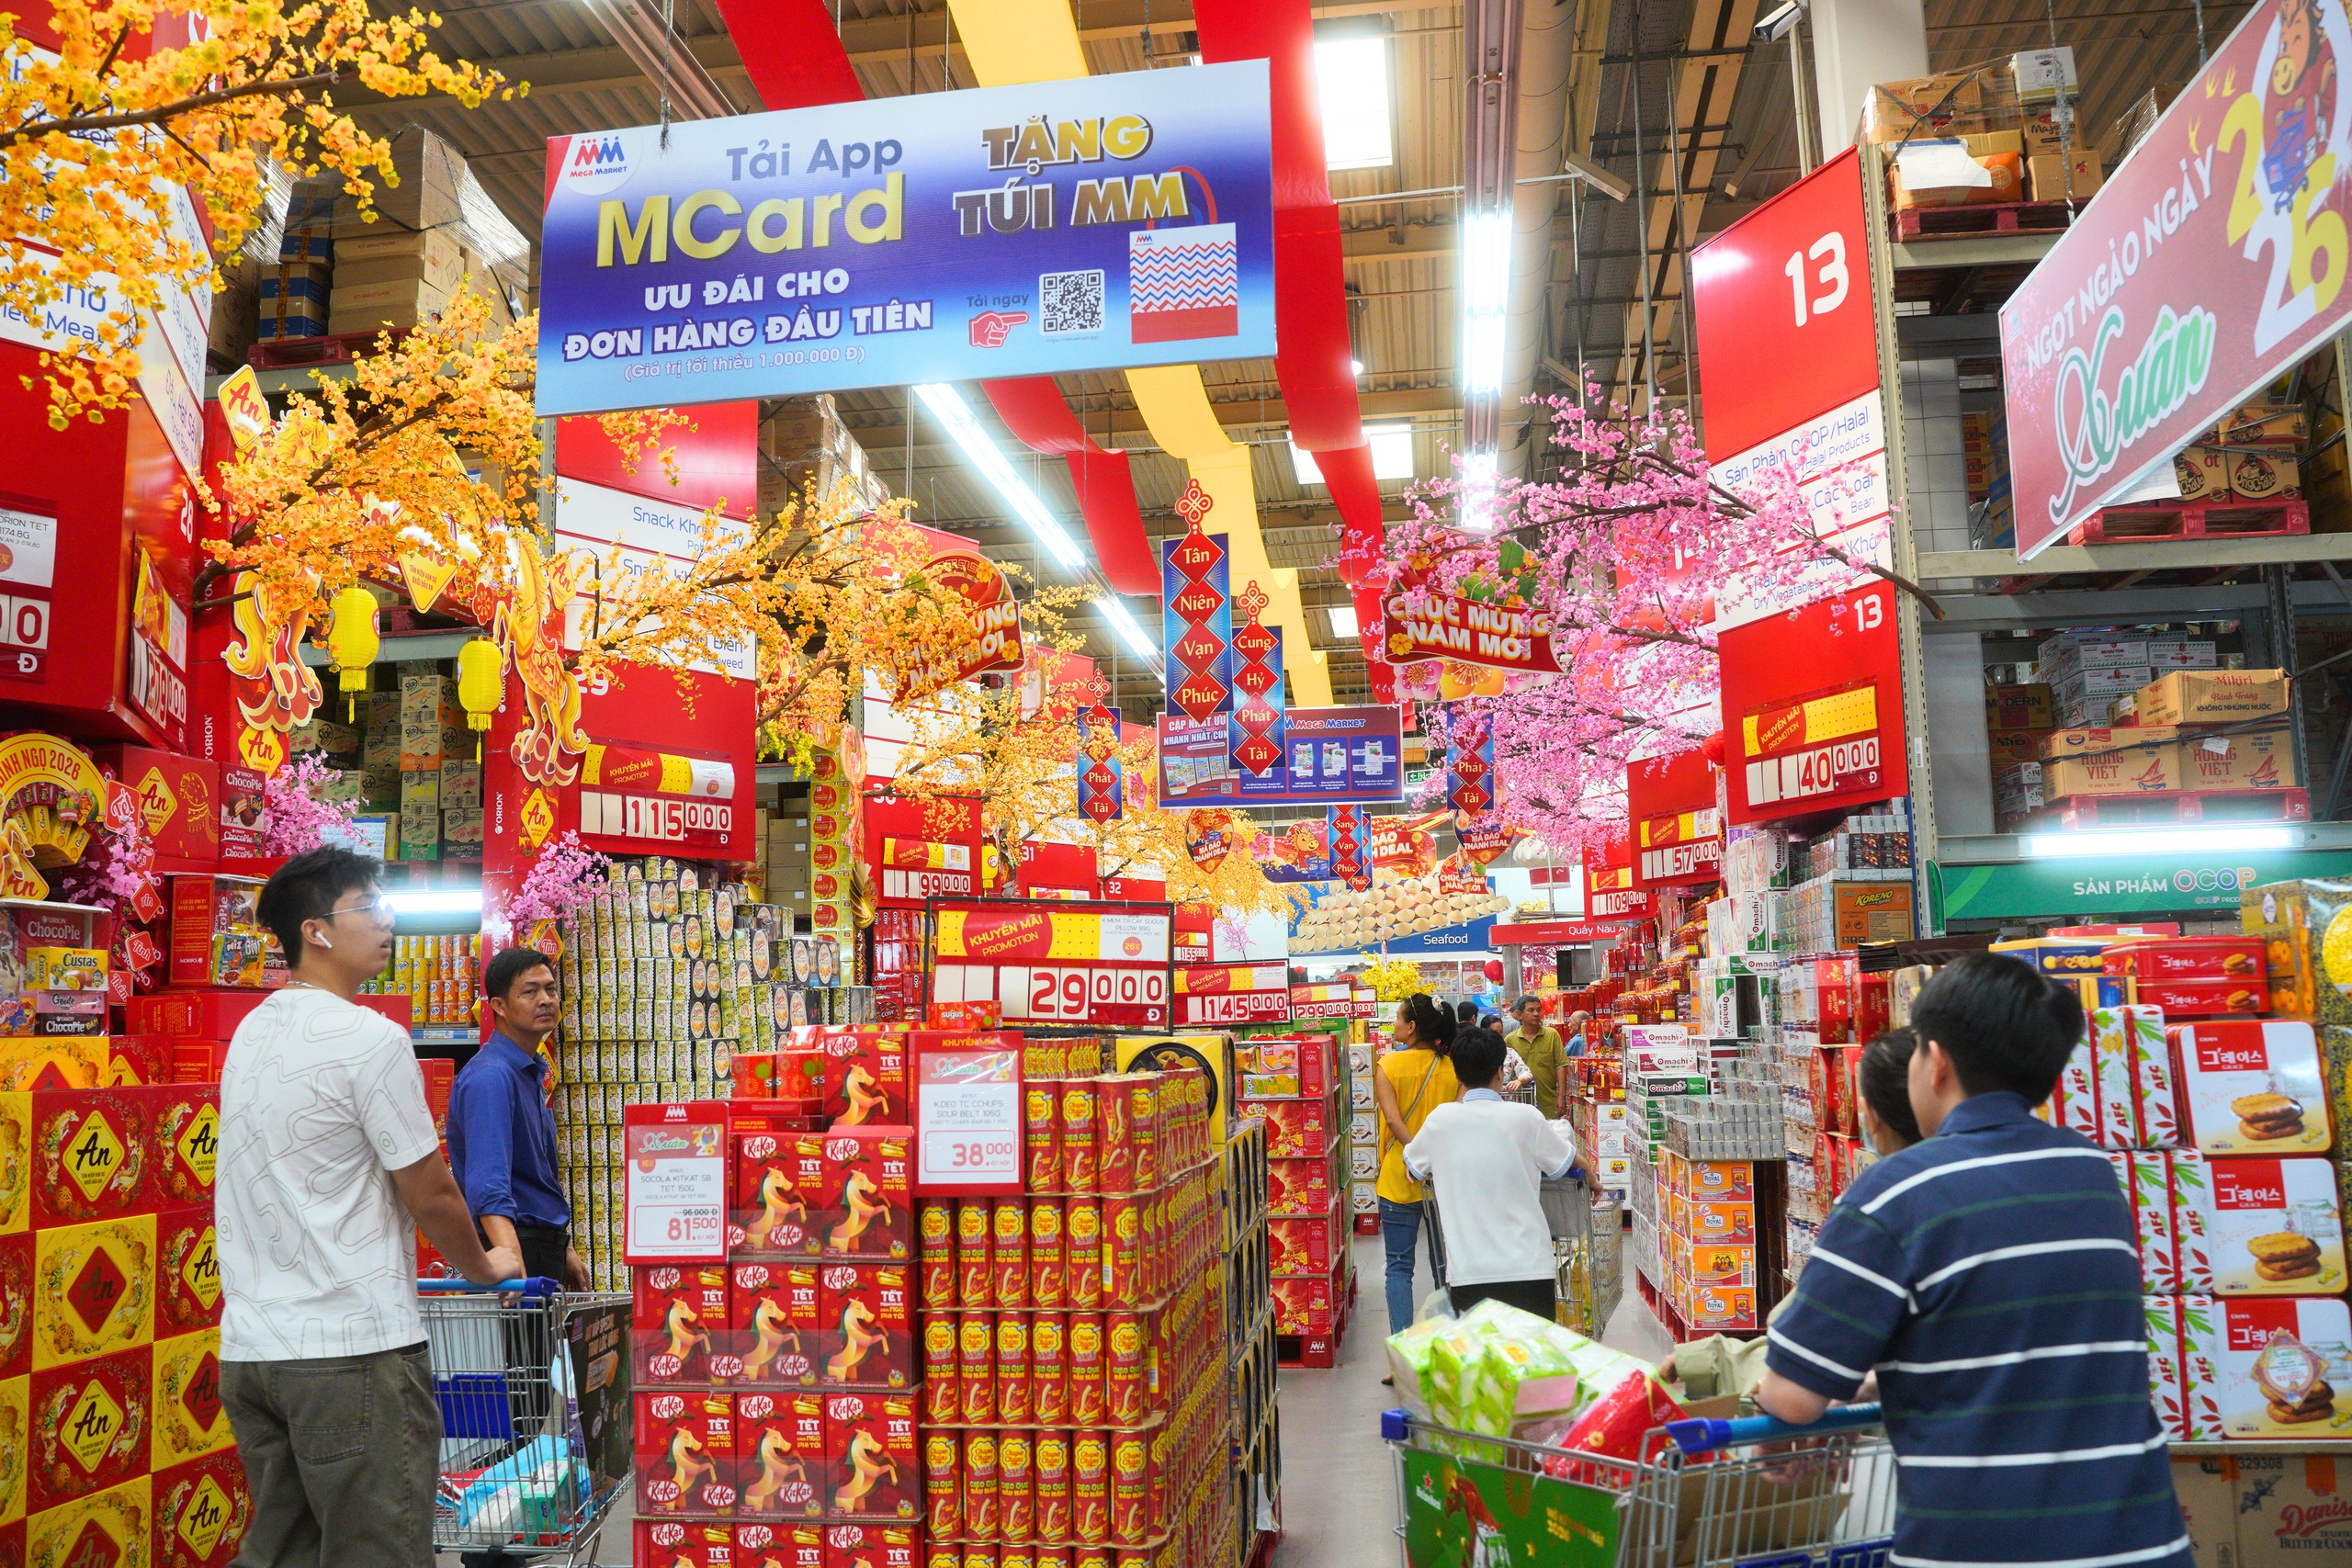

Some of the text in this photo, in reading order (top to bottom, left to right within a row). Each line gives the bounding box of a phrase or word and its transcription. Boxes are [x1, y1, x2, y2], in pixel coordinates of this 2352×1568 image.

[982, 115, 1153, 175] TẶNG
[726, 138, 902, 181] Tải App
[953, 171, 1192, 235] TÚI MM
[597, 172, 902, 267] MCard
[1785, 231, 1849, 327] 13
[645, 268, 849, 310] ƯU ĐÃI CHO
[967, 294, 1029, 308] Tải ngay
[564, 299, 932, 360] ĐƠN HÀNG ĐẦU TIÊN
[2027, 296, 2075, 378] NGỌT
[624, 346, 865, 381] (Giá trị tối thiểu 1.000.000 Đ)
[229, 382, 260, 423] An
[2049, 304, 2217, 525] Xuân
[1829, 433, 1870, 458] Products
[1851, 497, 1874, 513] Bean
[1183, 547, 1210, 565] Tân
[1180, 595, 1216, 614] Niên
[1854, 593, 1883, 632] 13
[1238, 636, 1272, 651] Cung
[1406, 621, 1471, 651] NĂM
[1183, 639, 1214, 659] Vạn
[1247, 671, 1265, 688] Hỷ
[2214, 673, 2254, 685] Mikiri
[1182, 686, 1219, 705] Phúc
[1985, 696, 2041, 707] MODERN
[1169, 720, 1186, 731] CẬP
[1215, 715, 1226, 726] ƯU
[1242, 708, 1272, 724] Phát
[1760, 705, 1800, 744] KHUYẾN MÃI
[1768, 721, 1799, 750] PROMOTION
[247, 731, 275, 761] An
[1248, 746, 1268, 761] Tài
[1458, 761, 1483, 773] Phát
[2086, 765, 2119, 780] VIỆT
[2199, 762, 2232, 777] VIỆT
[227, 773, 262, 790] ChocoPie
[613, 770, 650, 784] PROMOTION
[1089, 773, 1112, 783] Phát
[141, 787, 169, 813] An
[1464, 792, 1479, 804] Tài
[1093, 802, 1108, 813] Tài
[2295, 804, 2305, 813] 25
[1335, 819, 1354, 829] Sang
[224, 831, 252, 843] ChocoPie
[1654, 825, 1668, 840] KHUYẾN
[1657, 829, 1672, 843] PROMOTION
[1339, 841, 1353, 851] Vạn
[1381, 841, 1413, 858] DEAL
[1021, 847, 1035, 863] 31
[1337, 863, 1356, 873] Phúc
[1109, 882, 1121, 894] 32
[2074, 867, 2256, 896] SẢN PHẨM OCOP
[1855, 890, 1894, 907] KORENO
[2195, 896, 2220, 905] OCOP
[1568, 924, 1593, 936] Quầy
[1423, 933, 1468, 944] Seafood
[62, 953, 97, 967] Custas
[2162, 957, 2195, 968] 그레이스
[2165, 994, 2199, 1005] 그레이스
[941, 1010, 965, 1020] sugus
[46, 1022, 85, 1032] ChocoPie
[827, 1037, 857, 1054] KitKat
[880, 1055, 901, 1067] TẾT
[2202, 1047, 2263, 1065] 그레이스
[2071, 1068, 2089, 1095] AFC
[2148, 1065, 2167, 1091] AFC
[744, 1137, 776, 1157] KitKat
[826, 1139, 859, 1159] KitKat
[799, 1160, 821, 1171] TẾT
[1706, 1216, 1723, 1225] ROYAL
[2147, 1211, 2166, 1237] AFC
